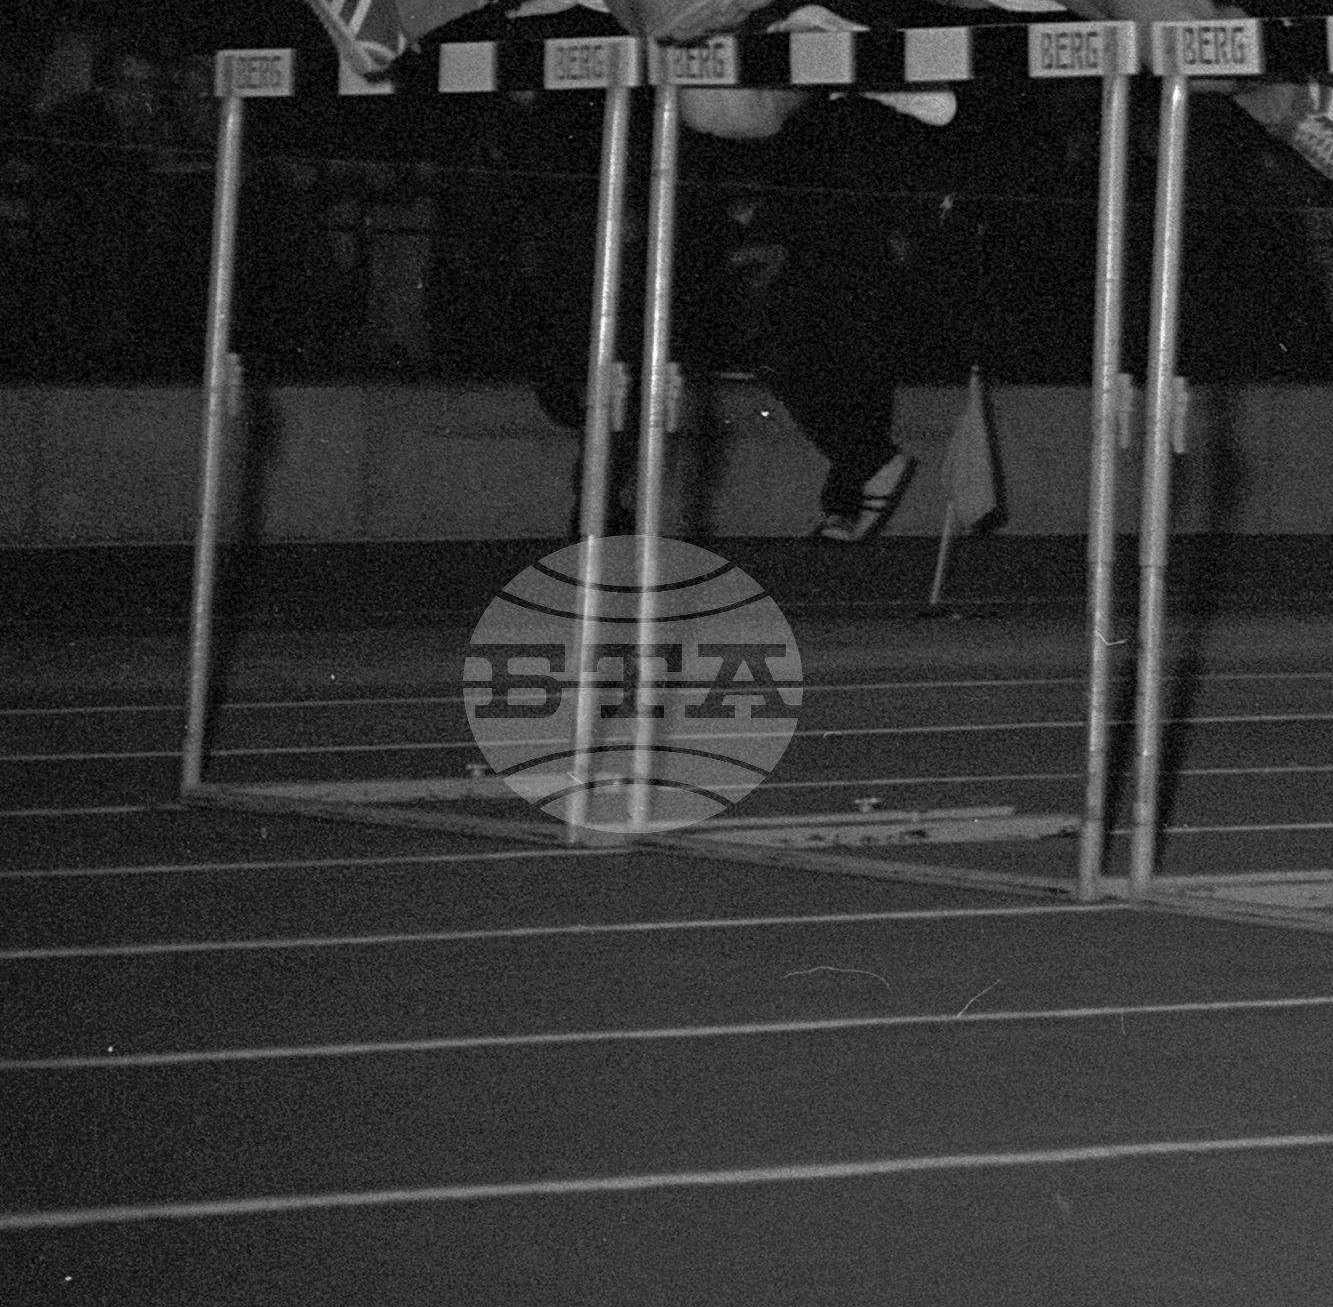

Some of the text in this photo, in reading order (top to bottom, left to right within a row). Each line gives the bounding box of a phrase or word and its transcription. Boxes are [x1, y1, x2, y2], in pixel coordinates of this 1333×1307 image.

[556, 44, 604, 80] BERG
[1041, 31, 1100, 69] BERG
[1183, 25, 1246, 65] BERG
